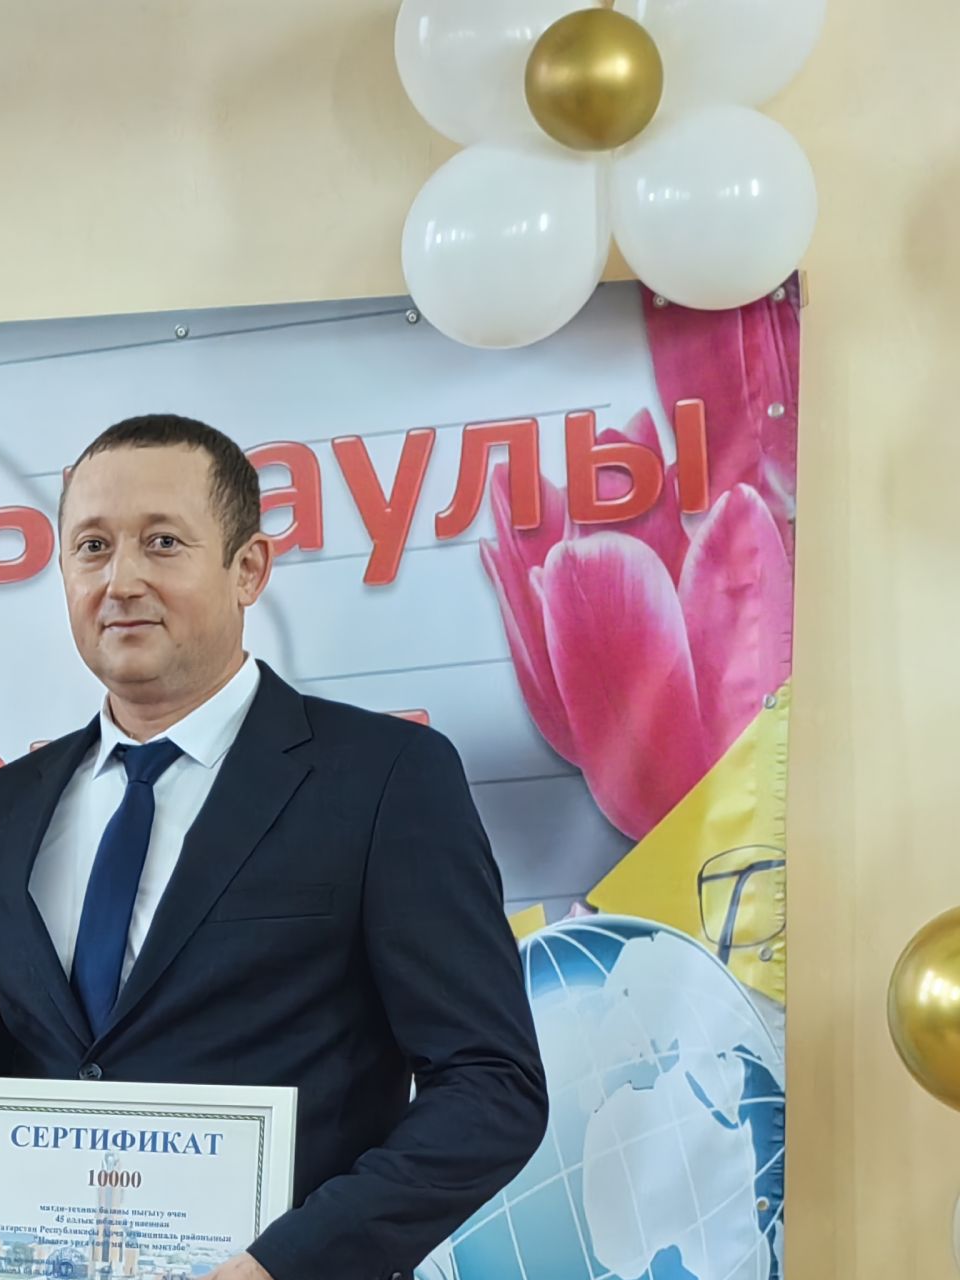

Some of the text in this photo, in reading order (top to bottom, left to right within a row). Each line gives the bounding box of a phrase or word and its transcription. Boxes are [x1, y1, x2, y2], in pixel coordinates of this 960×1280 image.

[10, 1124, 224, 1156] СЕРТИФИКАТ
[88, 1169, 142, 1188] 10000
[55, 1215, 64, 1223] 45
